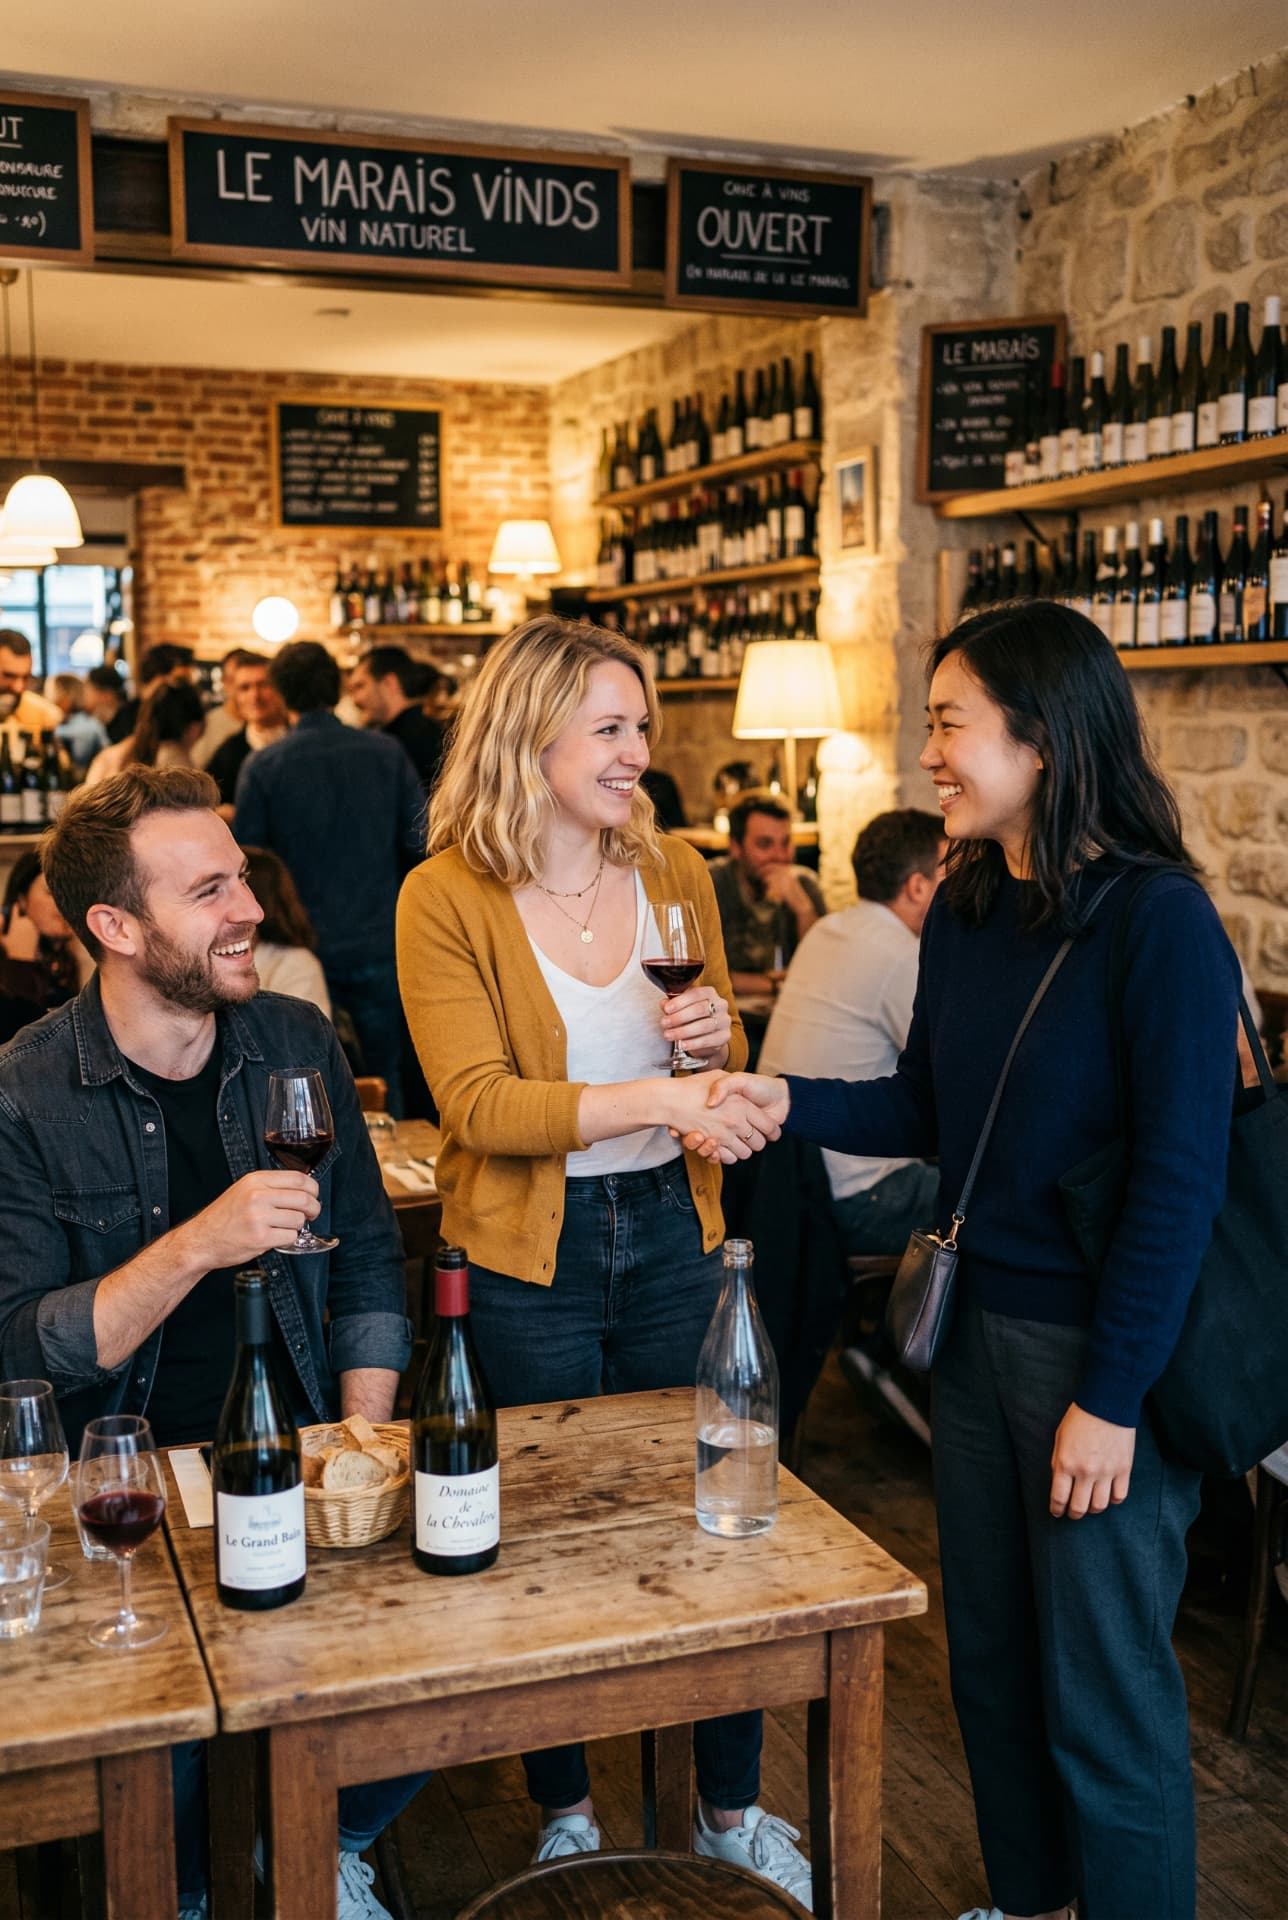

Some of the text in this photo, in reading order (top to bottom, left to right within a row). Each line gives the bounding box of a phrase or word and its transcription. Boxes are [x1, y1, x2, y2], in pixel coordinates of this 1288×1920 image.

[216, 149, 273, 203] LE
[359, 220, 477, 253] NATUREL
[696, 205, 833, 256] OUVERT
[942, 342, 967, 365] LE
[458, 1500, 473, 1514] de
[425, 1513, 438, 1529] la
[225, 1533, 238, 1547] Le
[240, 1534, 279, 1549] Grand
